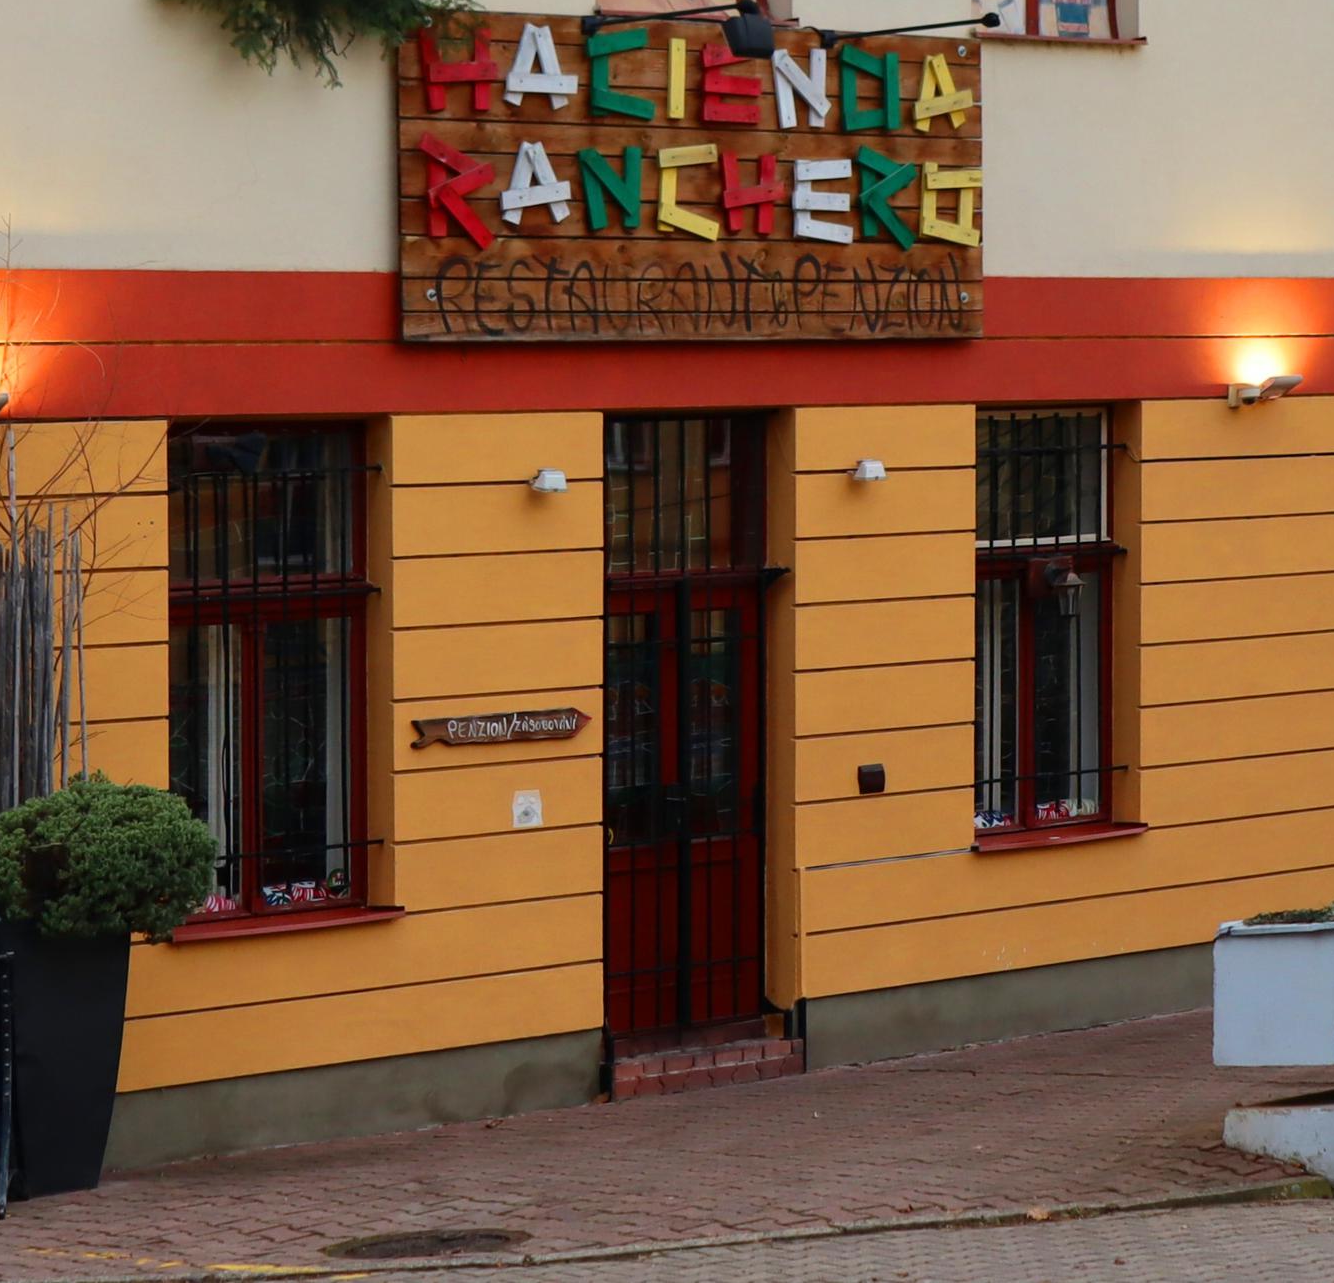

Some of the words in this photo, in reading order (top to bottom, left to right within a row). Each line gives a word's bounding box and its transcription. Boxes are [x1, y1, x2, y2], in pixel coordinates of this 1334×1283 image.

[419, 22, 975, 132] HACIENDA
[419, 132, 983, 250] RANCHERO
[434, 251, 767, 336] RESTAURANT
[792, 252, 964, 335] PENZION
